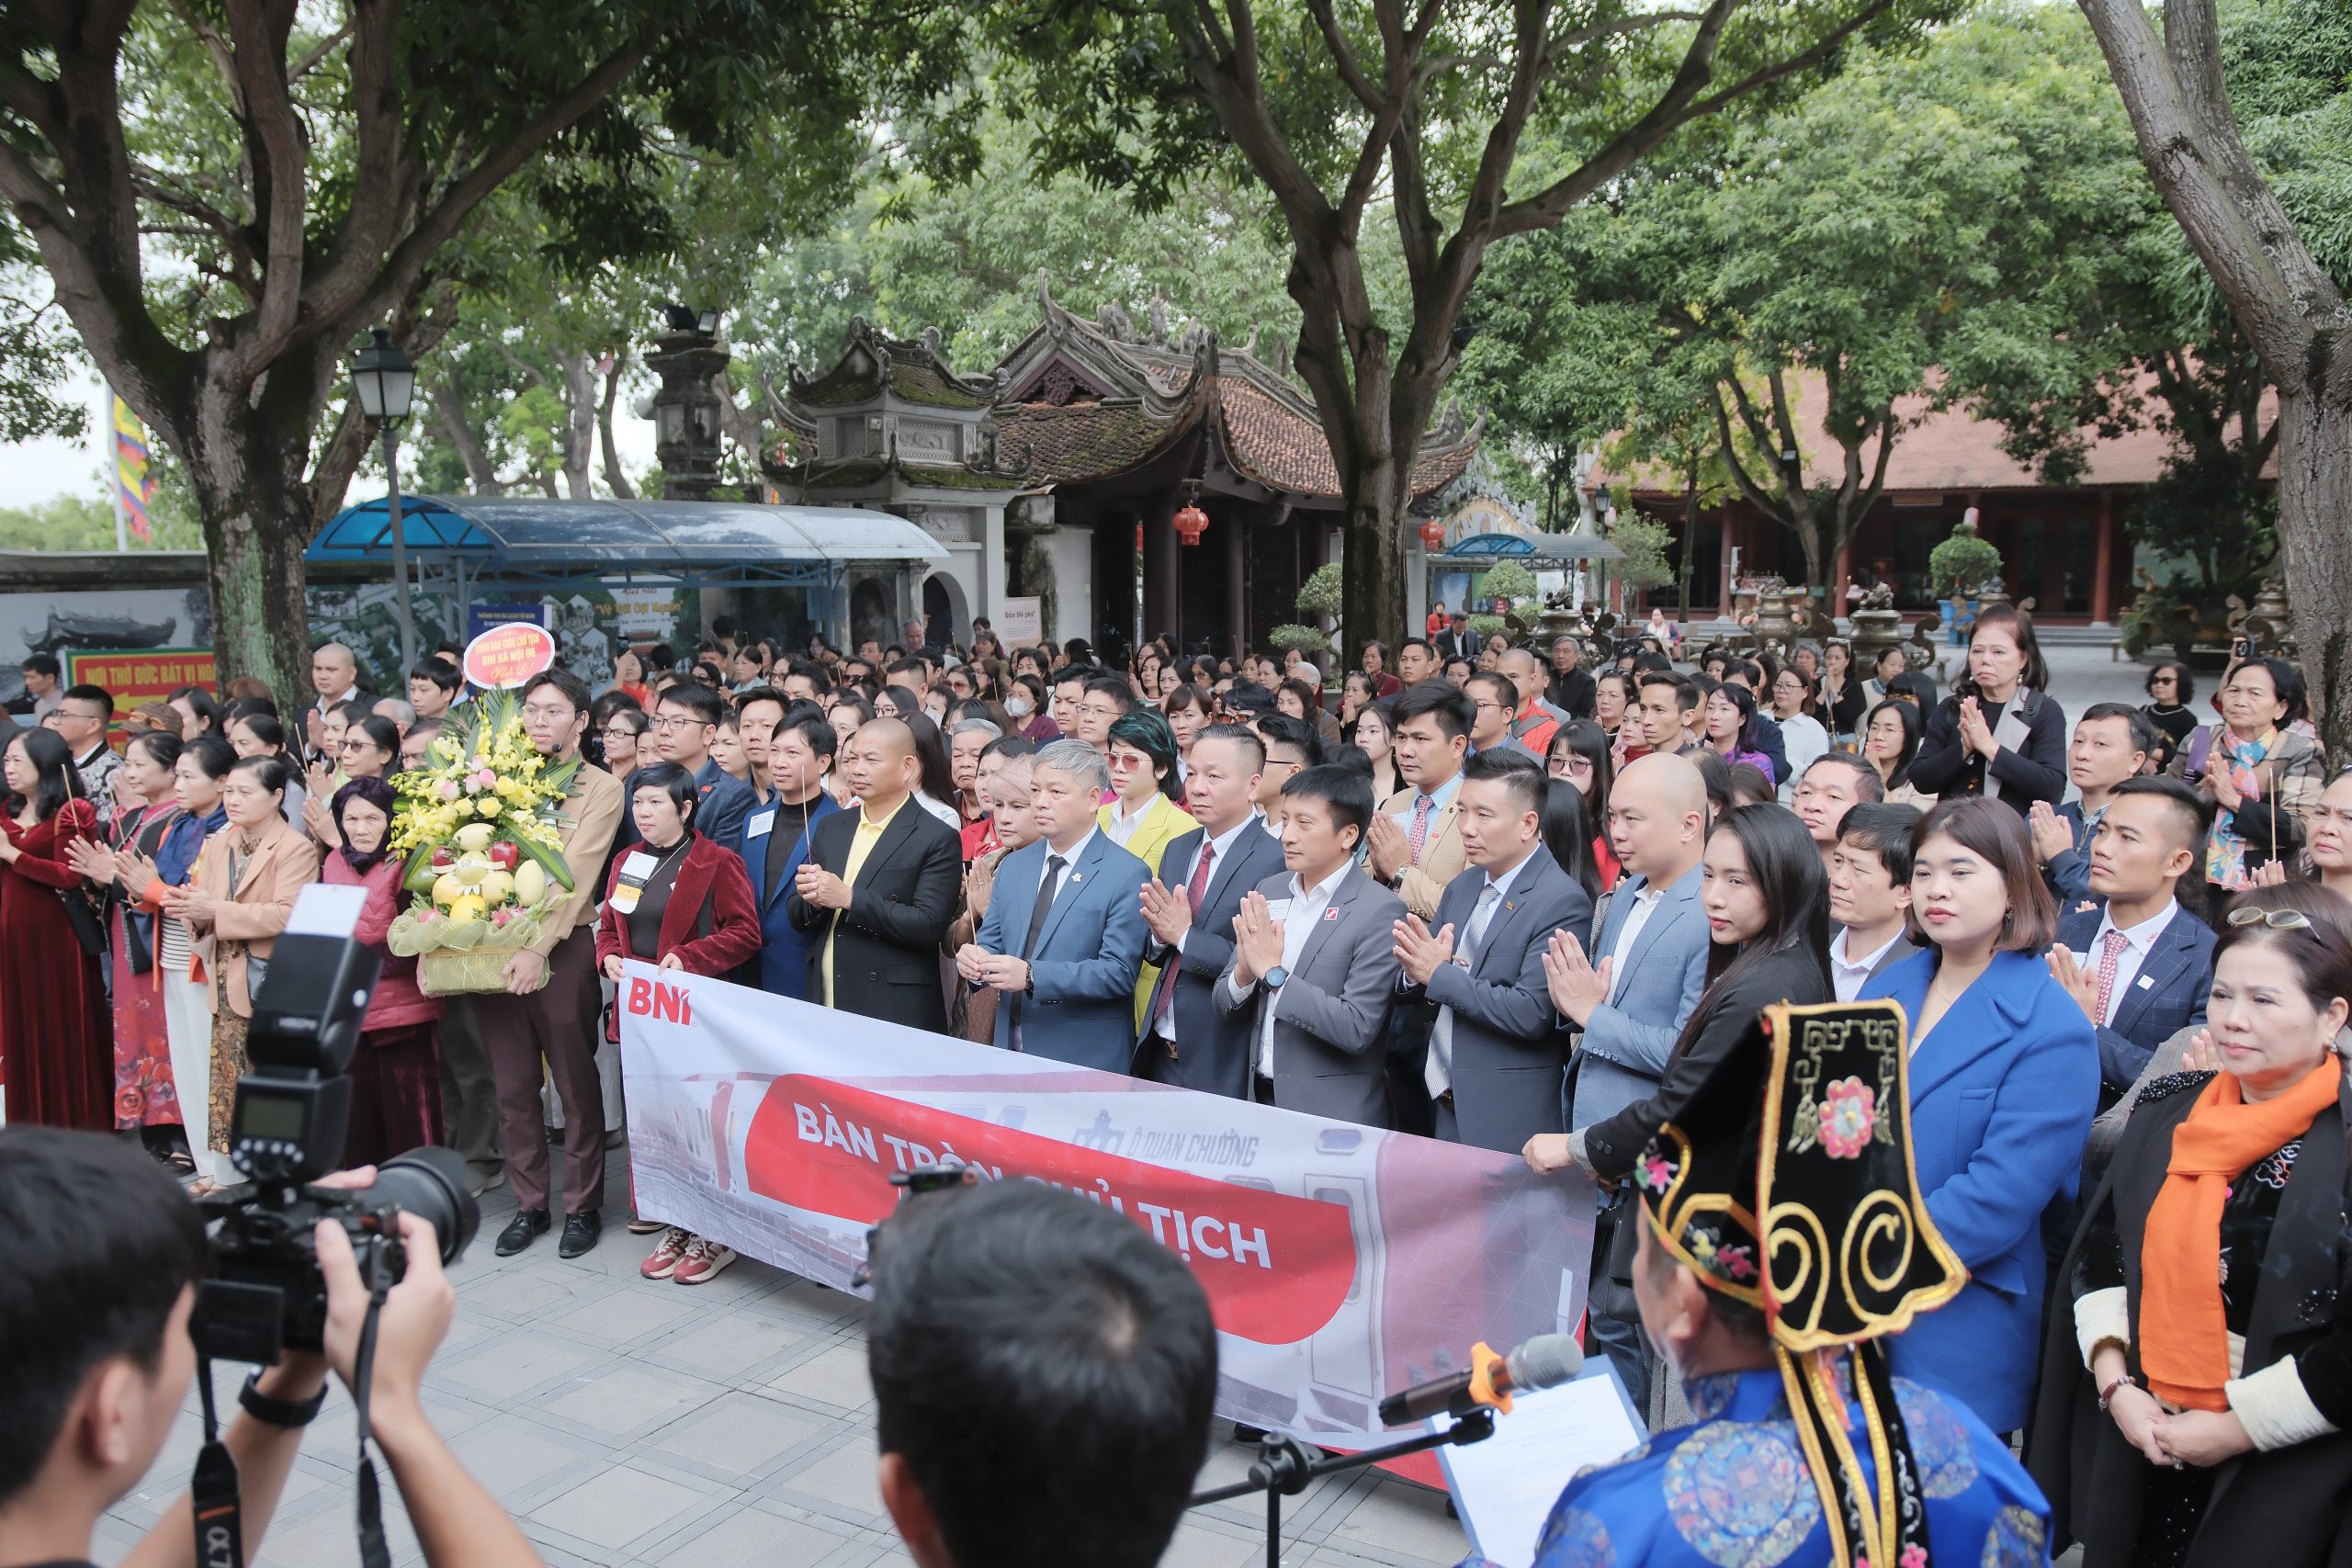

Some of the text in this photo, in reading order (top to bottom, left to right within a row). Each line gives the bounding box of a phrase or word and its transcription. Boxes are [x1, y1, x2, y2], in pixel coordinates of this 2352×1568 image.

[628, 976, 692, 1026] BNI
[794, 1102, 879, 1163] BÀN
[1137, 1201, 1272, 1269] TỊCH
